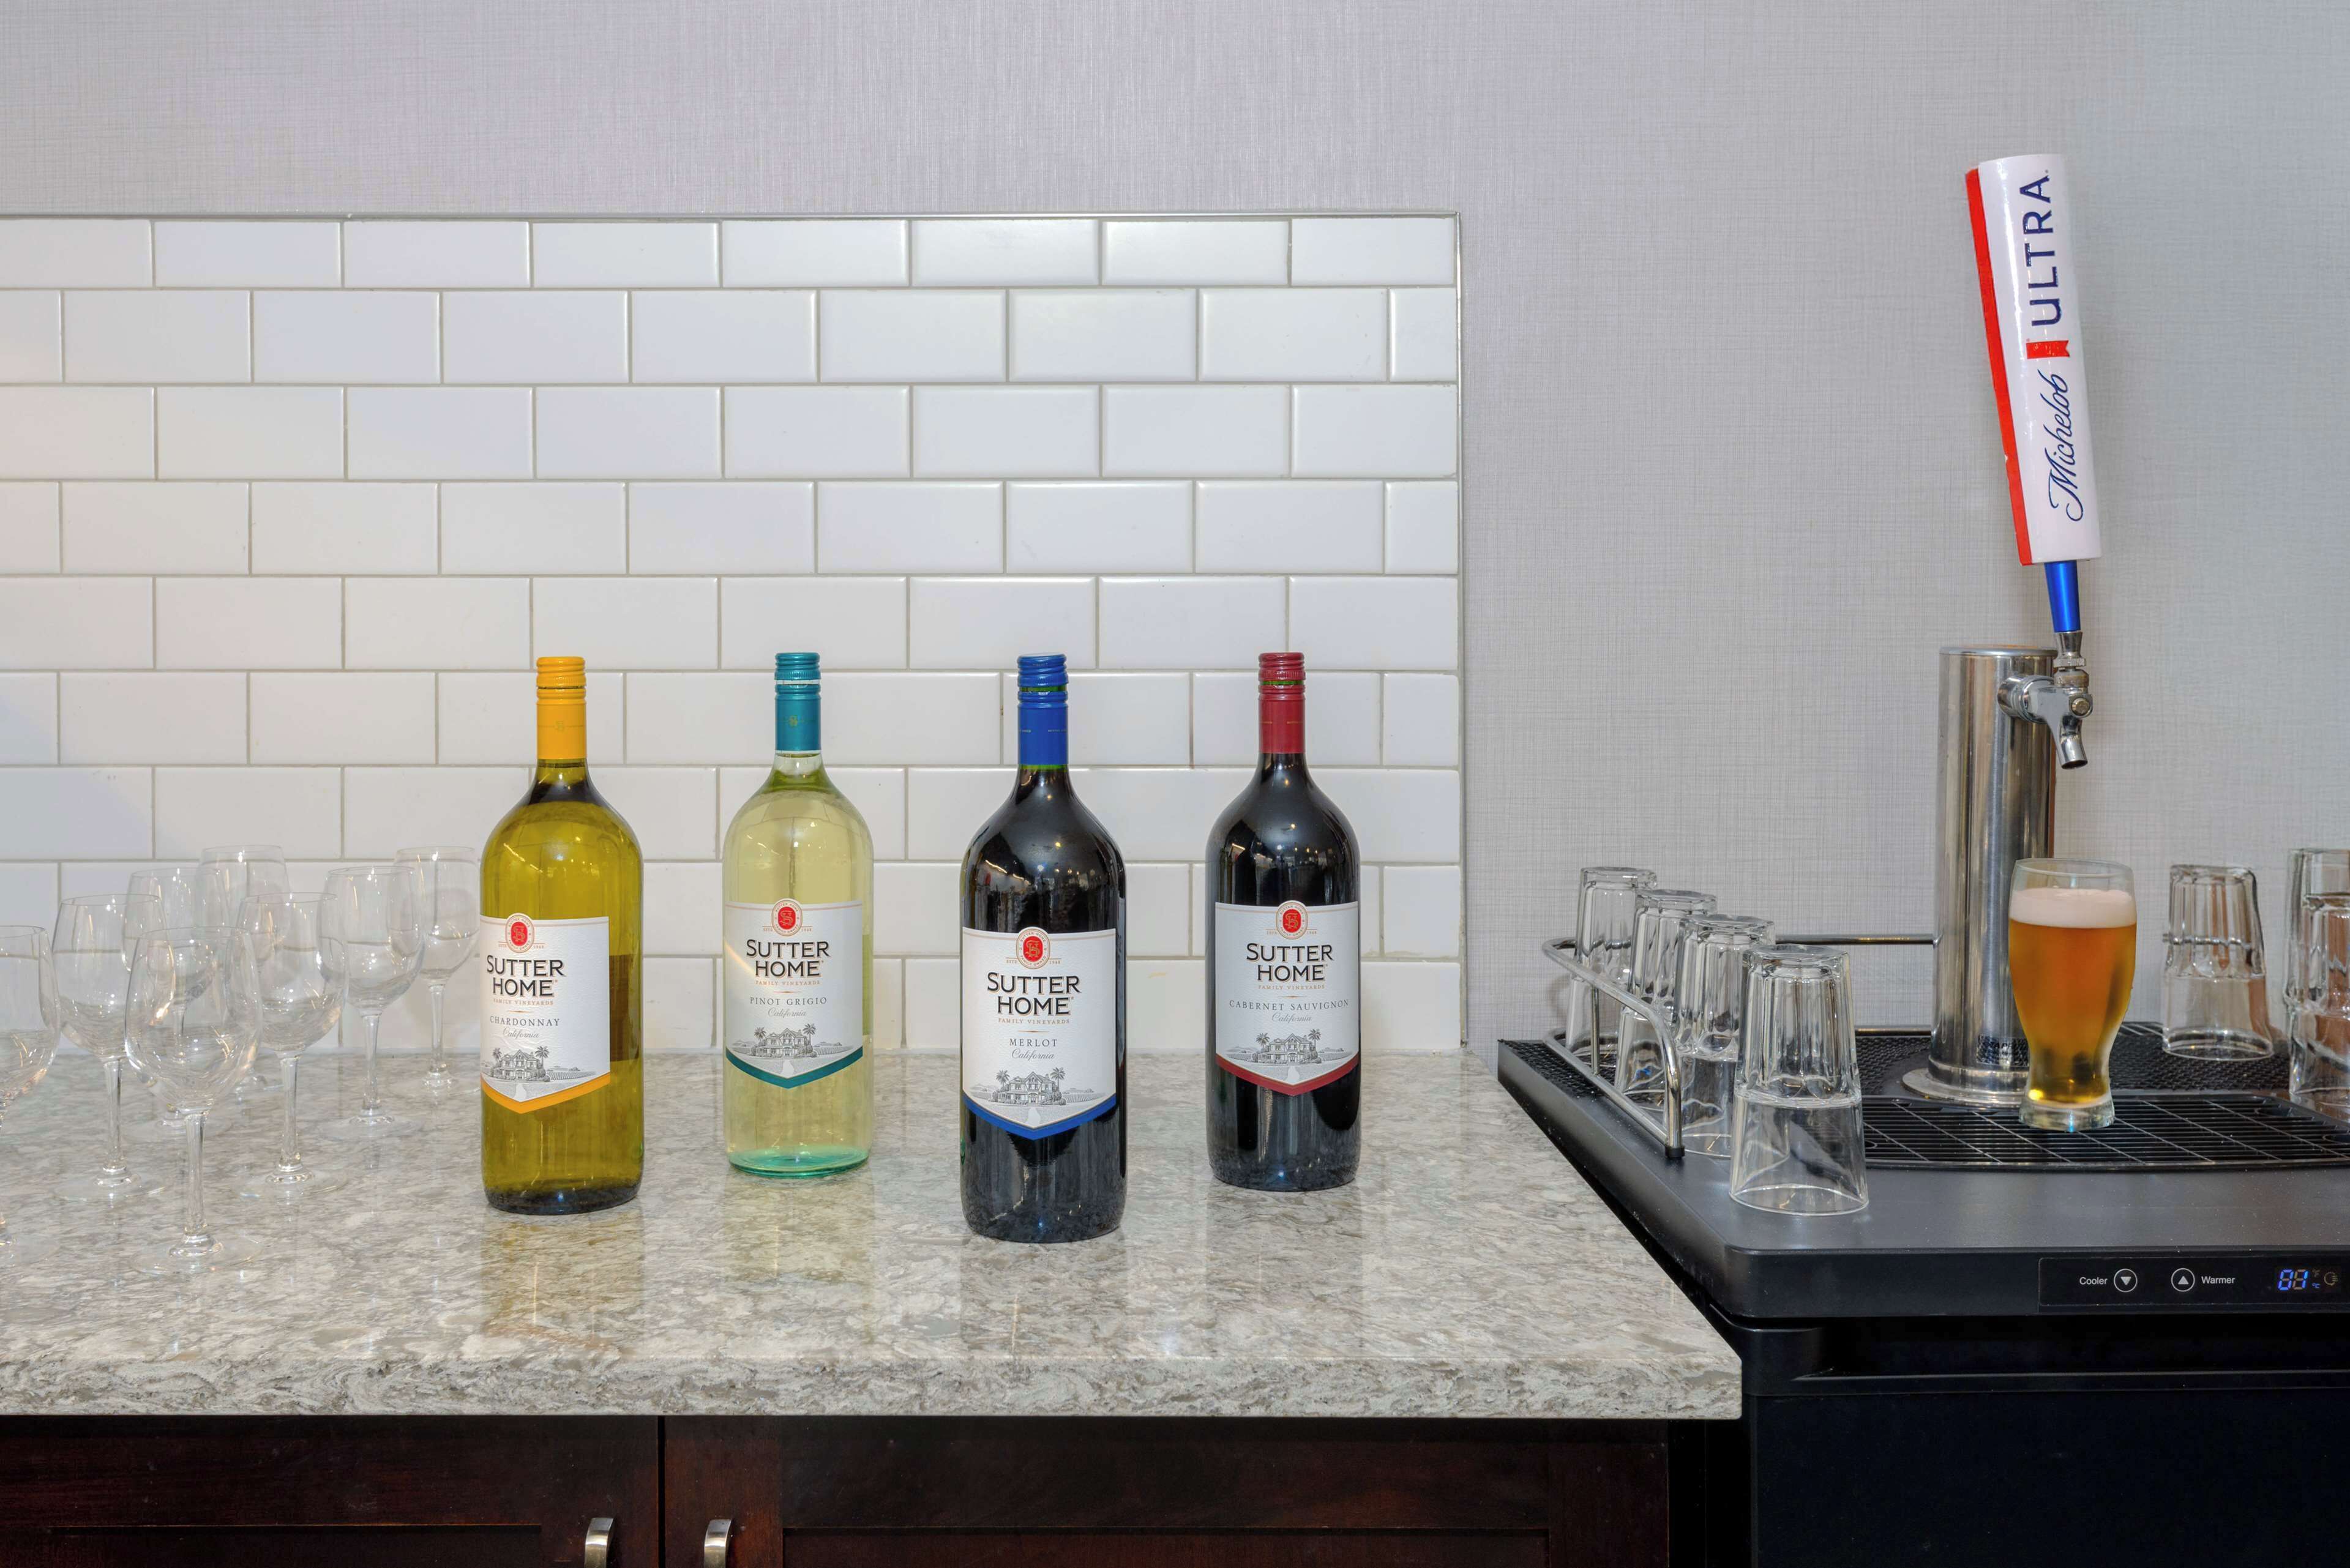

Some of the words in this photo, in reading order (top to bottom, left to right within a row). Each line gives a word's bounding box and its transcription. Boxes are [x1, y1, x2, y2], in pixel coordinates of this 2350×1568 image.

[2019, 174, 2062, 327] ULTRA
[2037, 368, 2084, 522] Michelob
[746, 939, 831, 958] SUTTER
[1246, 943, 1334, 961] SUTTER
[487, 954, 565, 976] SUTTER
[755, 961, 821, 977] HOME
[1257, 965, 1325, 982] HOME
[492, 977, 555, 996] HOME
[987, 972, 1082, 994] SUTTER
[750, 996, 780, 1006] PINOT
[786, 996, 828, 1006] GRIGIO
[997, 996, 1071, 1015] HOME
[1229, 999, 1285, 1010] CABERNET
[1290, 999, 1349, 1011] SAUVIGNON
[768, 1007, 808, 1018] California
[1271, 1012, 1313, 1024] California
[490, 1015, 560, 1026] CHARDONNAY
[503, 1028, 539, 1039] California
[1009, 1038, 1058, 1047] MERLOT
[1011, 1048, 1055, 1061] California
[2079, 1276, 2108, 1285] Cooler
[2201, 1275, 2236, 1285] Warmer
